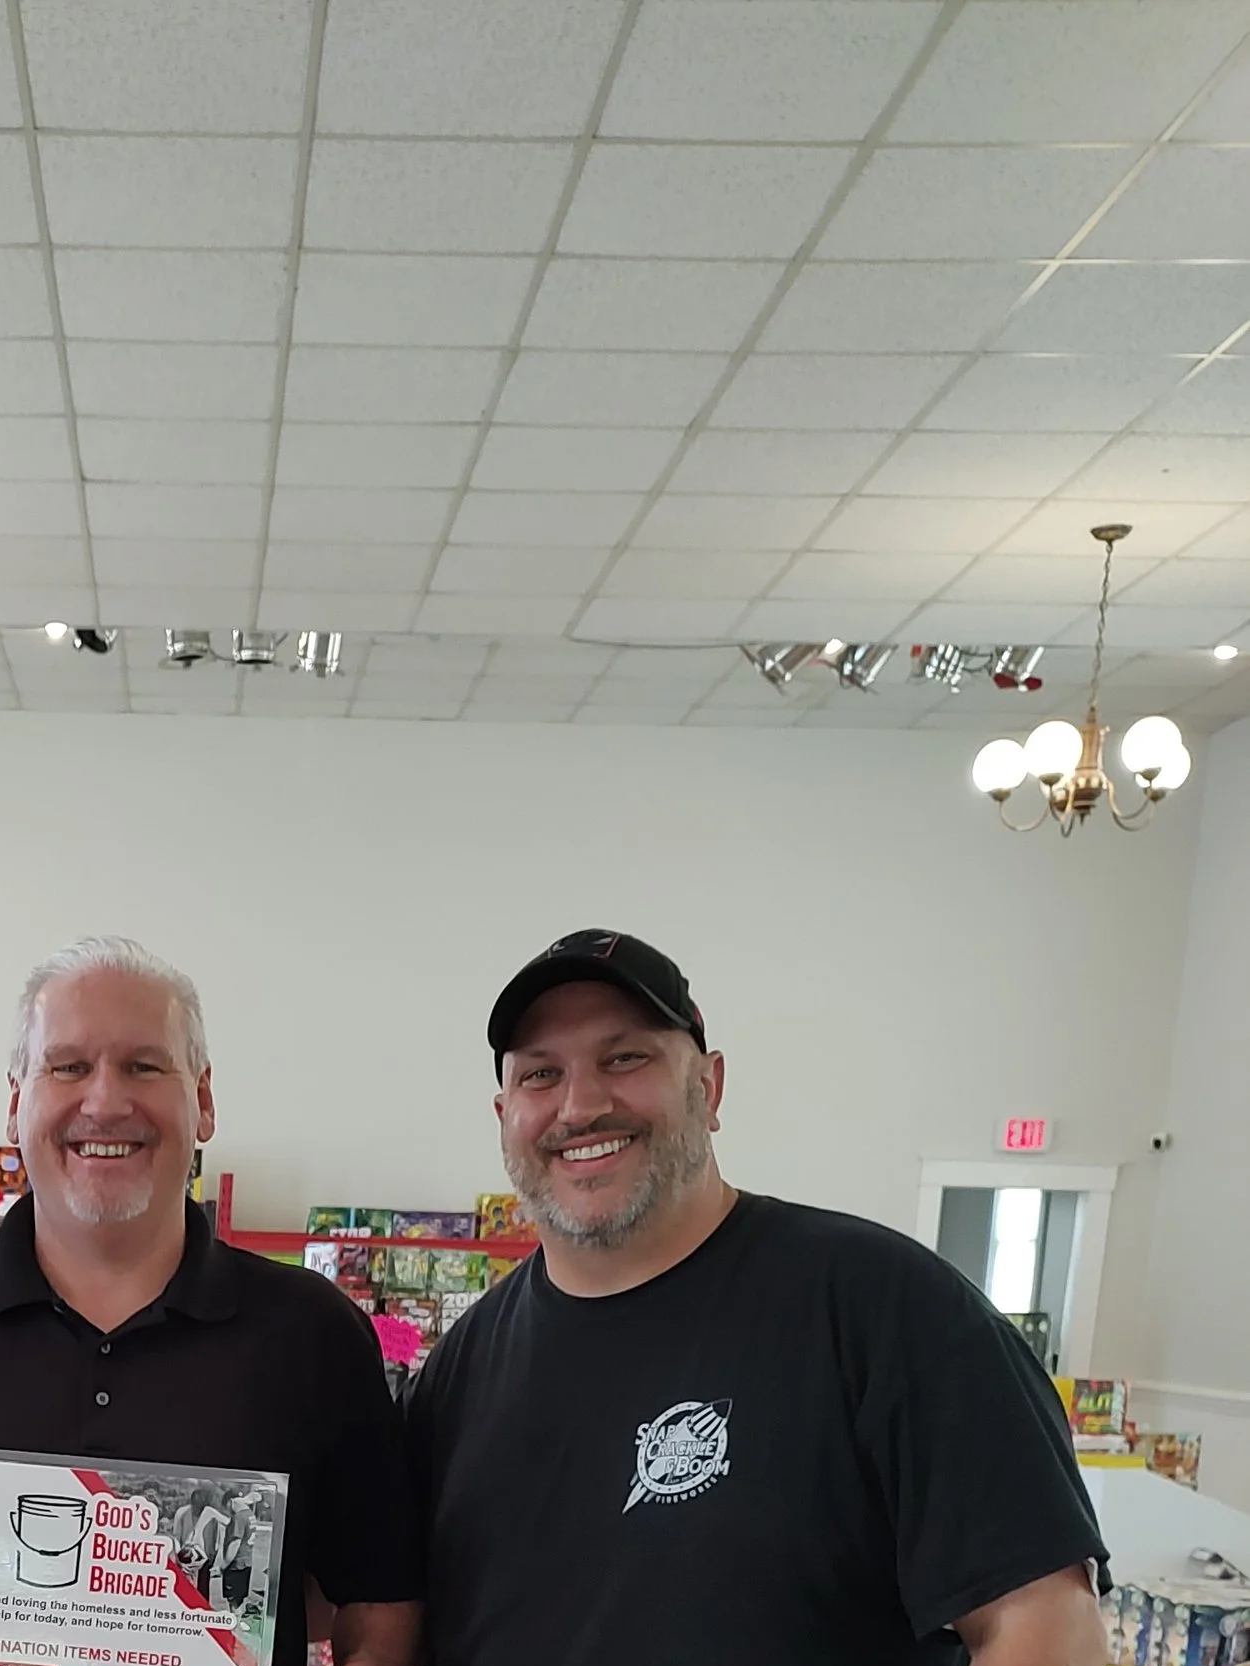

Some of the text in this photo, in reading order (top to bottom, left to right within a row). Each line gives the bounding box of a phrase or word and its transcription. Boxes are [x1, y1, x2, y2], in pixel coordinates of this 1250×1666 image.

[12, 1596, 47, 1610] loving
[50, 1600, 68, 1610] the
[71, 1602, 126, 1616] homeless
[129, 1608, 150, 1618] and
[154, 1609, 177, 1620] less
[181, 1611, 233, 1625] fortunate
[15, 1611, 31, 1621] for
[34, 1612, 68, 1627] today,
[71, 1617, 92, 1627] and
[96, 1619, 124, 1631] hope
[127, 1620, 144, 1631] for
[146, 1623, 205, 1637] tomorrow.
[64, 1645, 112, 1662] ITEMS
